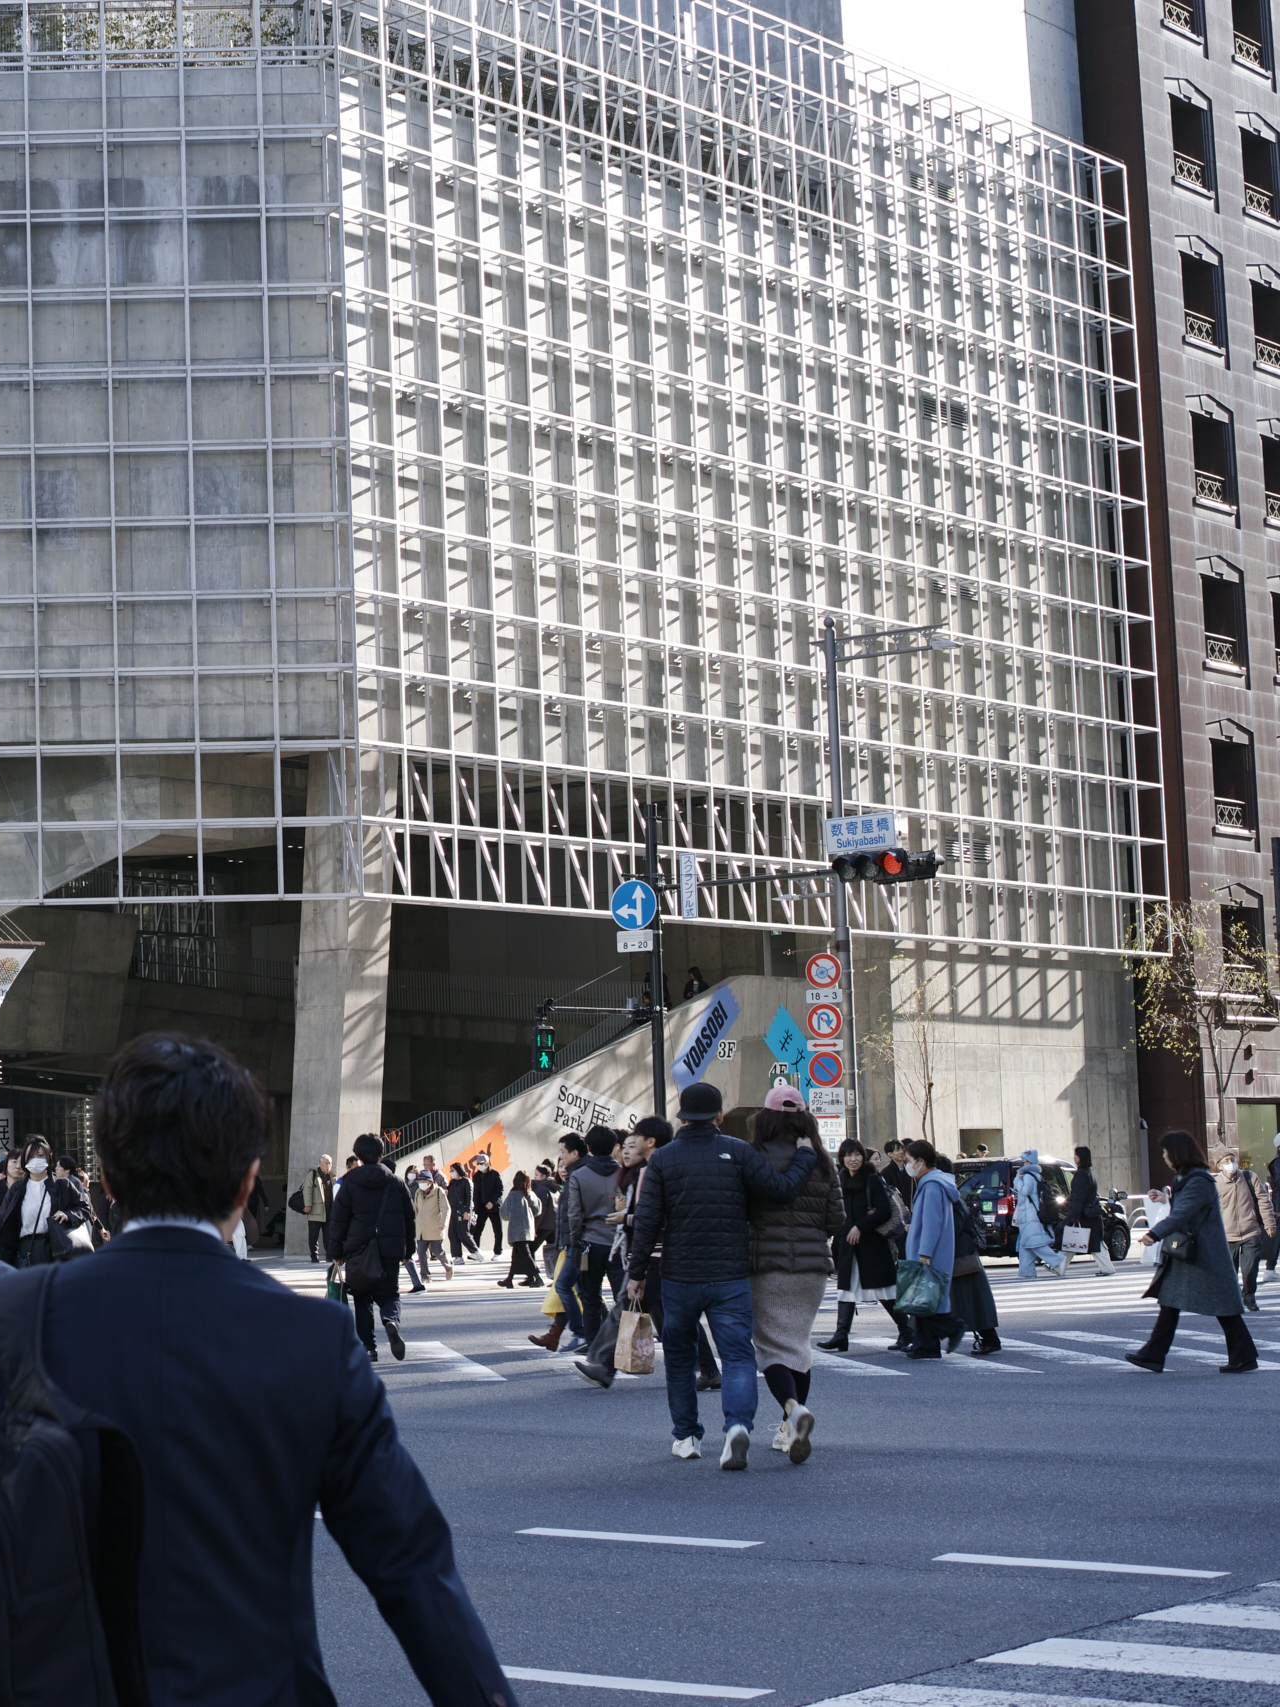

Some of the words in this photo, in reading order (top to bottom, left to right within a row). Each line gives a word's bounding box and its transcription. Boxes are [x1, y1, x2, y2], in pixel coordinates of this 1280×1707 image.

[831, 817, 889, 837] 数寄屋橋
[836, 834, 886, 848] Sukiyabashi
[683, 856, 694, 916] スクランブル式
[682, 1000, 729, 1076] YOASOBI
[718, 1041, 736, 1059] 3F
[557, 1084, 591, 1115] Sony
[553, 1106, 586, 1133] Park
[821, 1121, 829, 1129] JR
